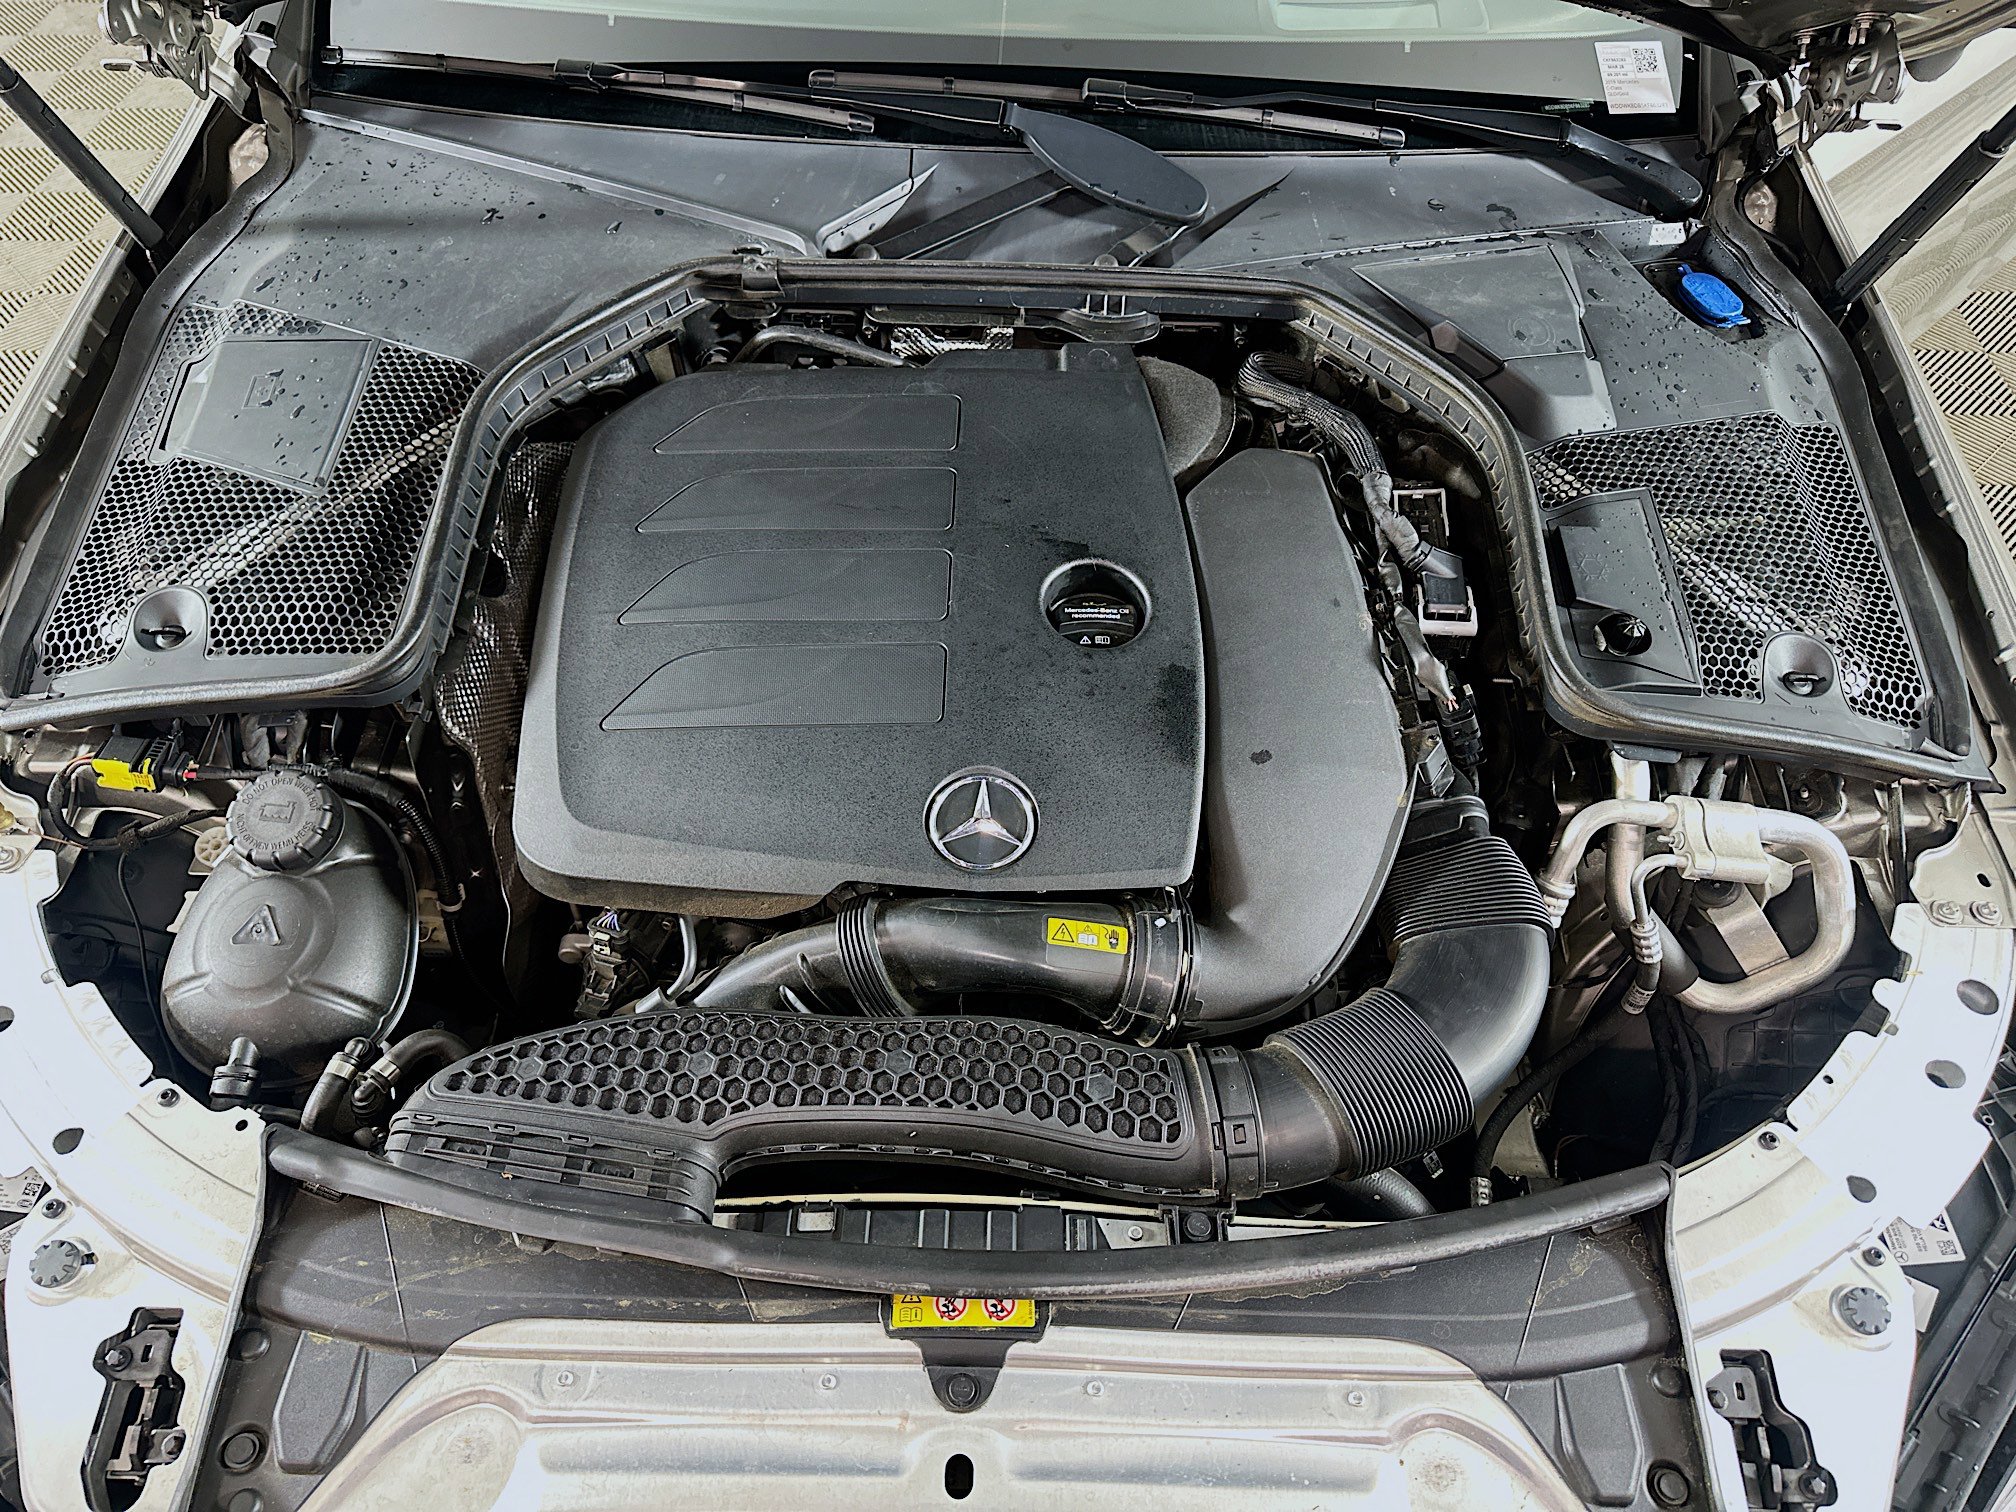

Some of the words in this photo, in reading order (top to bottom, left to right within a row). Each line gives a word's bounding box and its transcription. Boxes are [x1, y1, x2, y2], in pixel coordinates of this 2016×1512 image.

[242, 793, 254, 805] DO
[254, 781, 269, 795] NOT
[271, 777, 294, 786] OPEN
[294, 779, 313, 798] WHEN
[308, 796, 322, 811] HOT
[294, 820, 315, 841] HEISS
